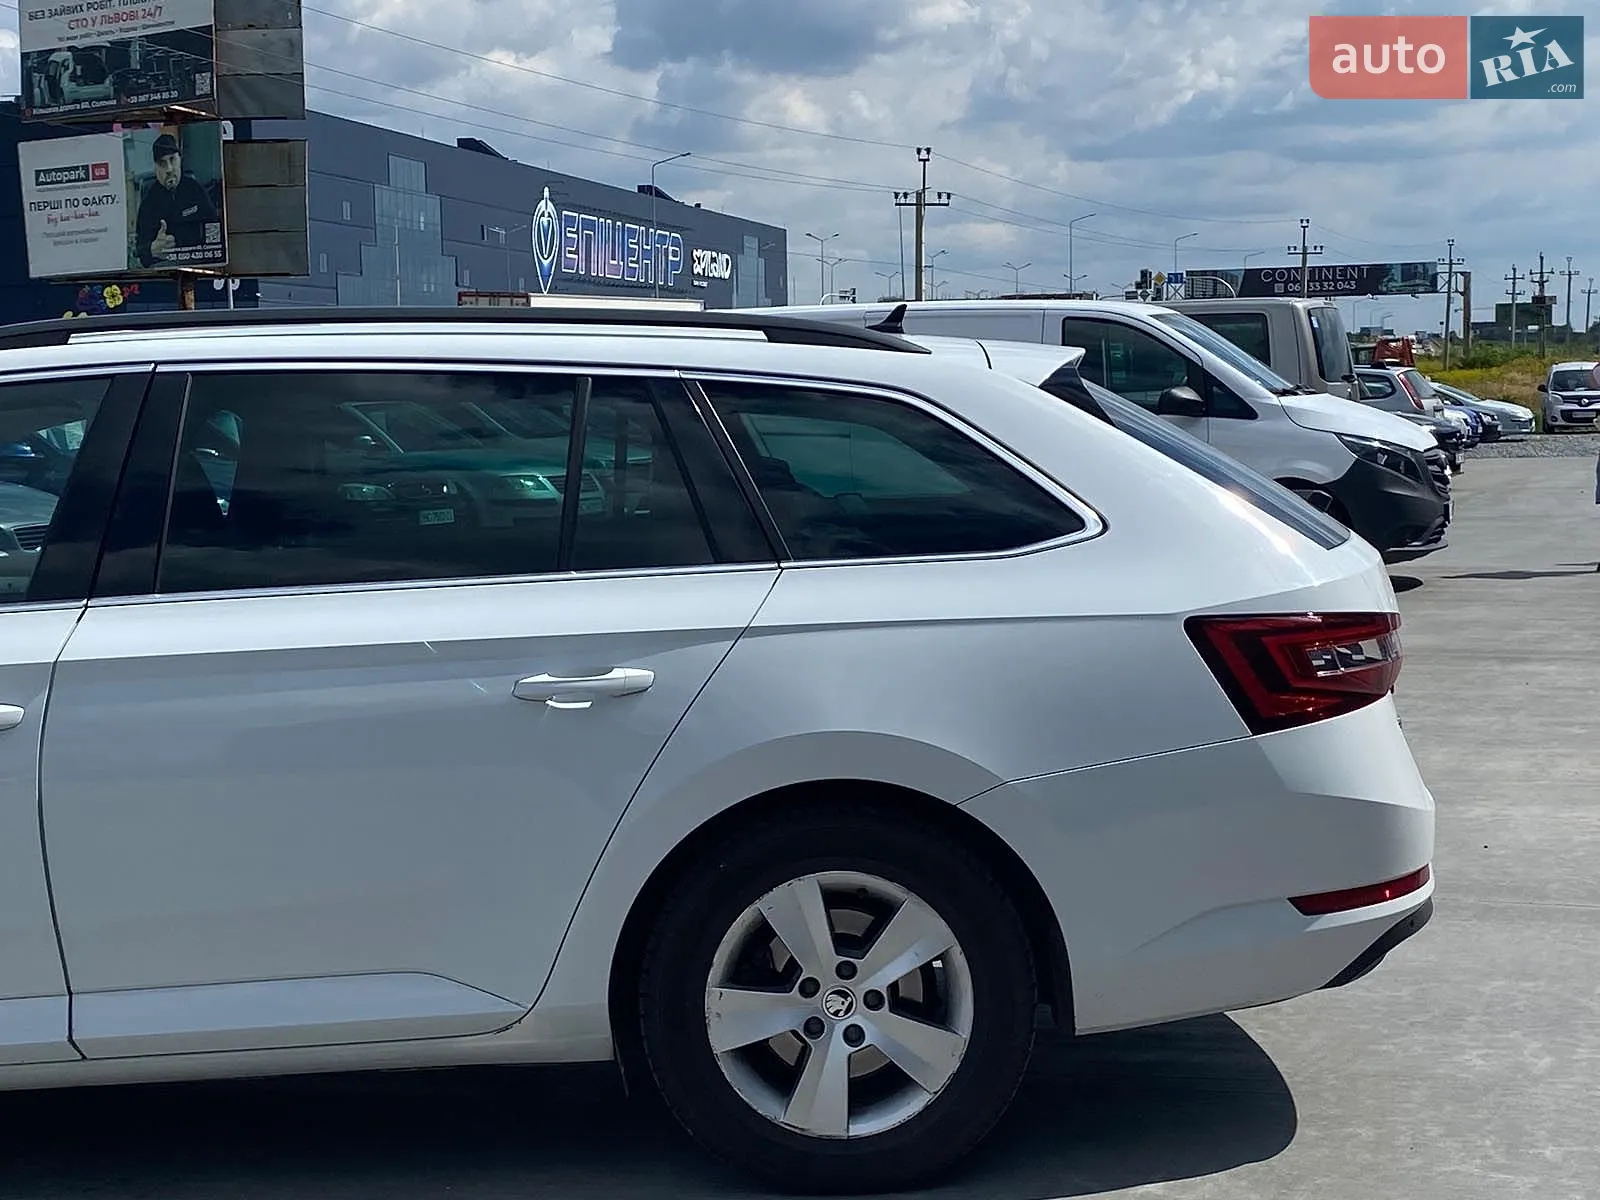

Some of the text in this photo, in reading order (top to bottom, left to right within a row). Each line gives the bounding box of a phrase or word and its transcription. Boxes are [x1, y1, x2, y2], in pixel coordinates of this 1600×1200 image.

[28, 10, 46, 21] БЕЗ
[48, 3, 84, 18] ЗАЙВИХ
[67, 5, 163, 30] СТО У ЛЬВОВІ 24/7
[38, 167, 106, 183] Autopark ua
[29, 194, 120, 212] ПЕРШІ ПО ФАКТУ.
[561, 210, 684, 287] ЕПІЦЕНТР
